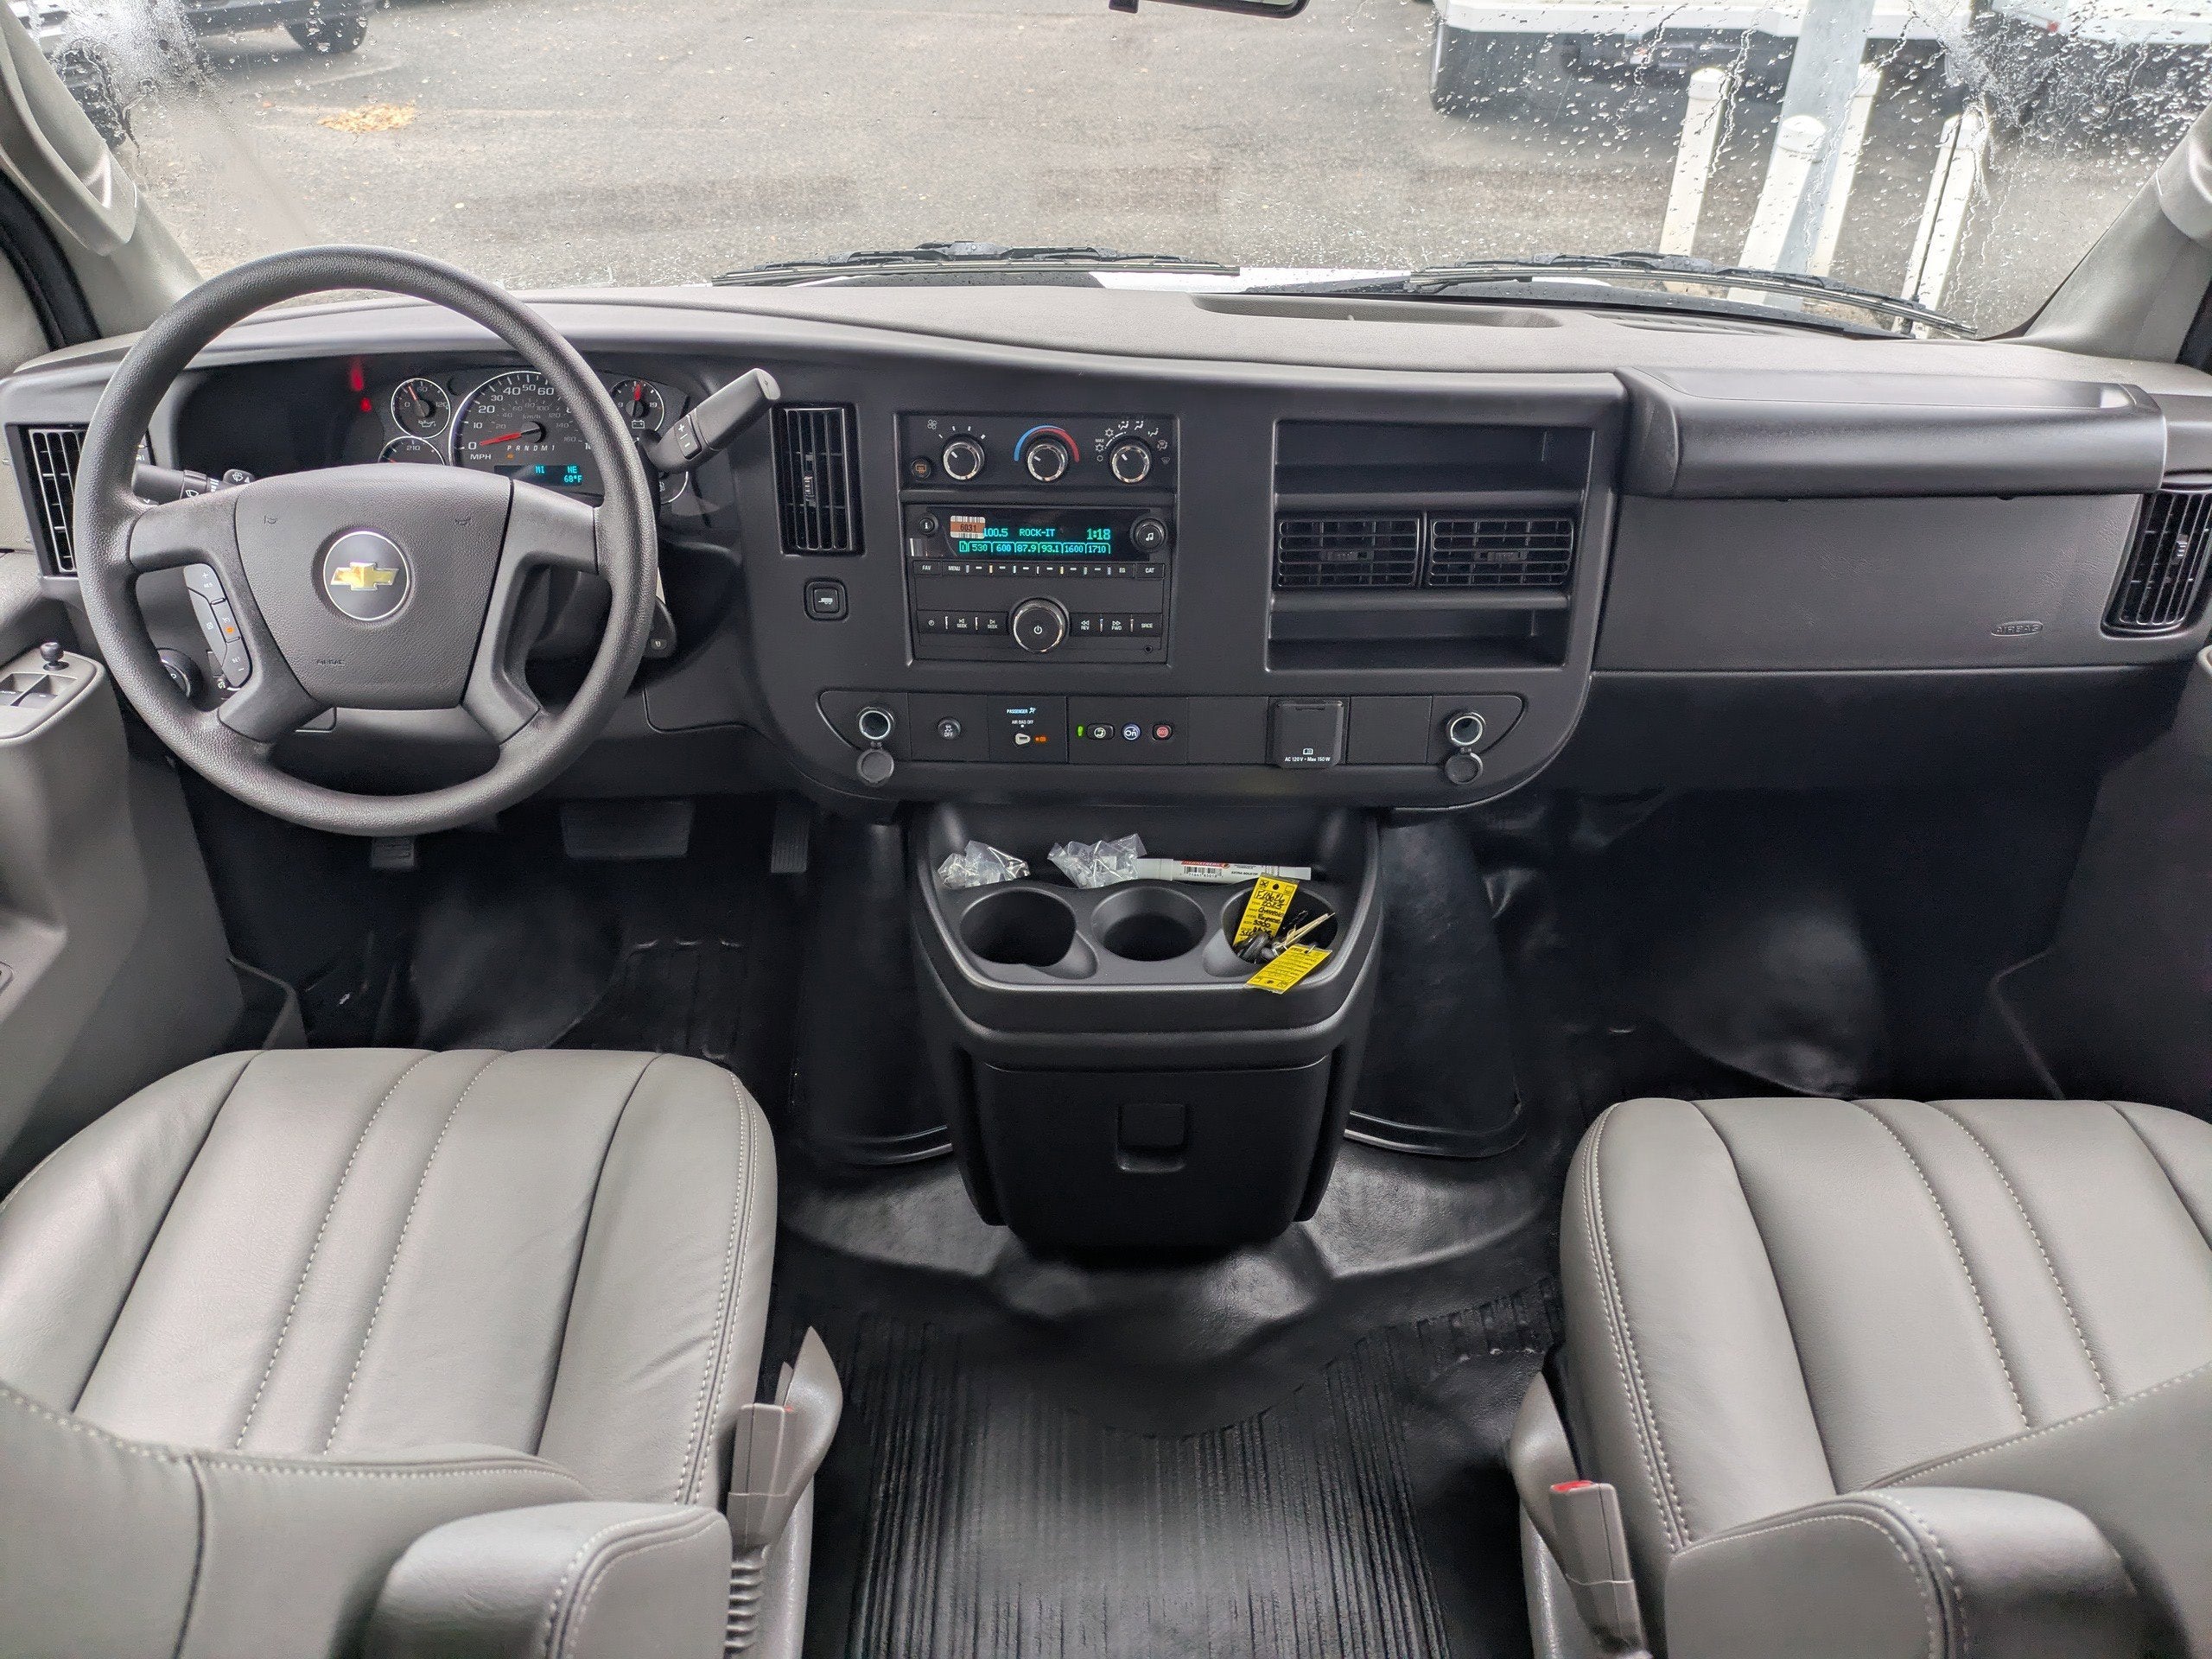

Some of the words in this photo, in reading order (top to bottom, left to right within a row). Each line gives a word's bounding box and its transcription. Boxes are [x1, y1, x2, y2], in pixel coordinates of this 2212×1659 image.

[503, 387, 521, 395] 40
[537, 387, 554, 395] 60
[478, 405, 495, 413] 20
[468, 442, 477, 450] 0
[535, 466, 545, 474] MI
[567, 466, 577, 474] NE
[983, 528, 1008, 537] 100.5
[1019, 528, 1055, 537] ROCK-IT
[1087, 528, 1111, 540] 1:18
[1017, 544, 1036, 552] 87.9
